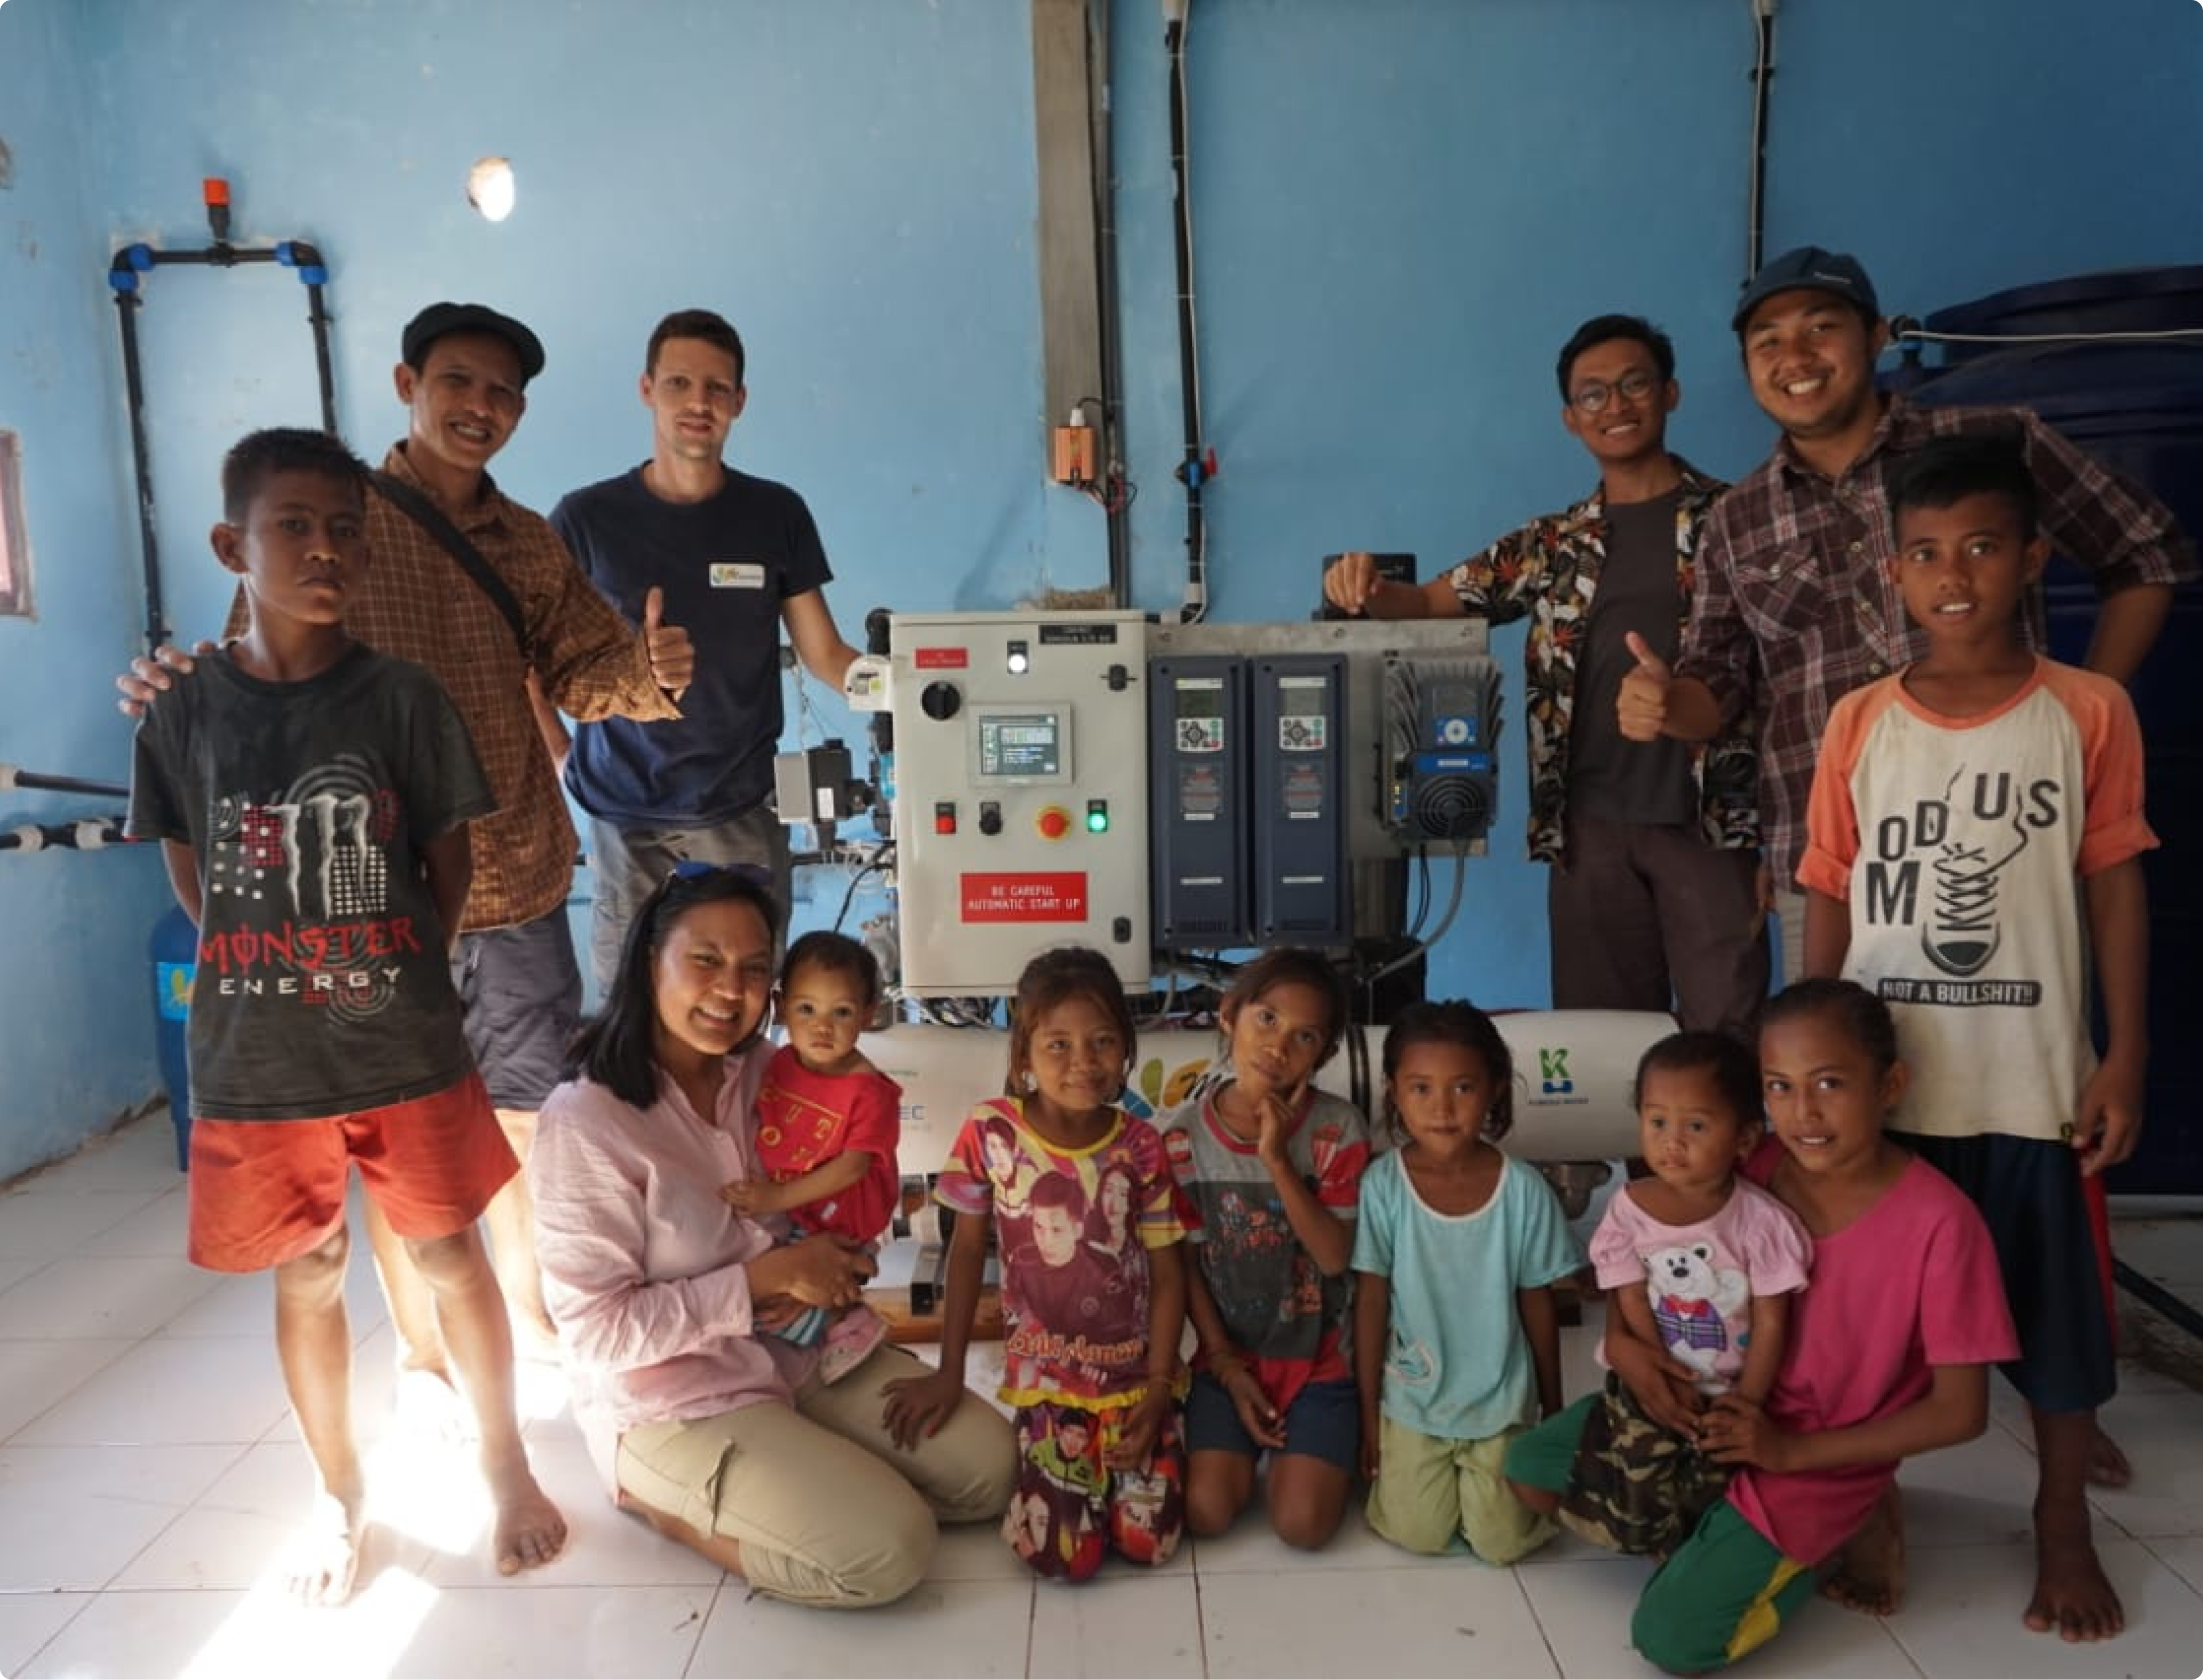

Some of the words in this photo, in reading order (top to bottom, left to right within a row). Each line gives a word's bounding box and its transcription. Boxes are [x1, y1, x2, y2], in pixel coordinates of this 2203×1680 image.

[991, 885, 1004, 896] BE
[1010, 885, 1054, 896] CAREFUL
[967, 899, 1023, 911] AUTOMATIC
[1030, 899, 1060, 909] START
[1066, 899, 1080, 910] UP
[219, 967, 400, 995] ENERGY
[1883, 981, 1912, 998] NOT
[1920, 982, 1932, 999] A
